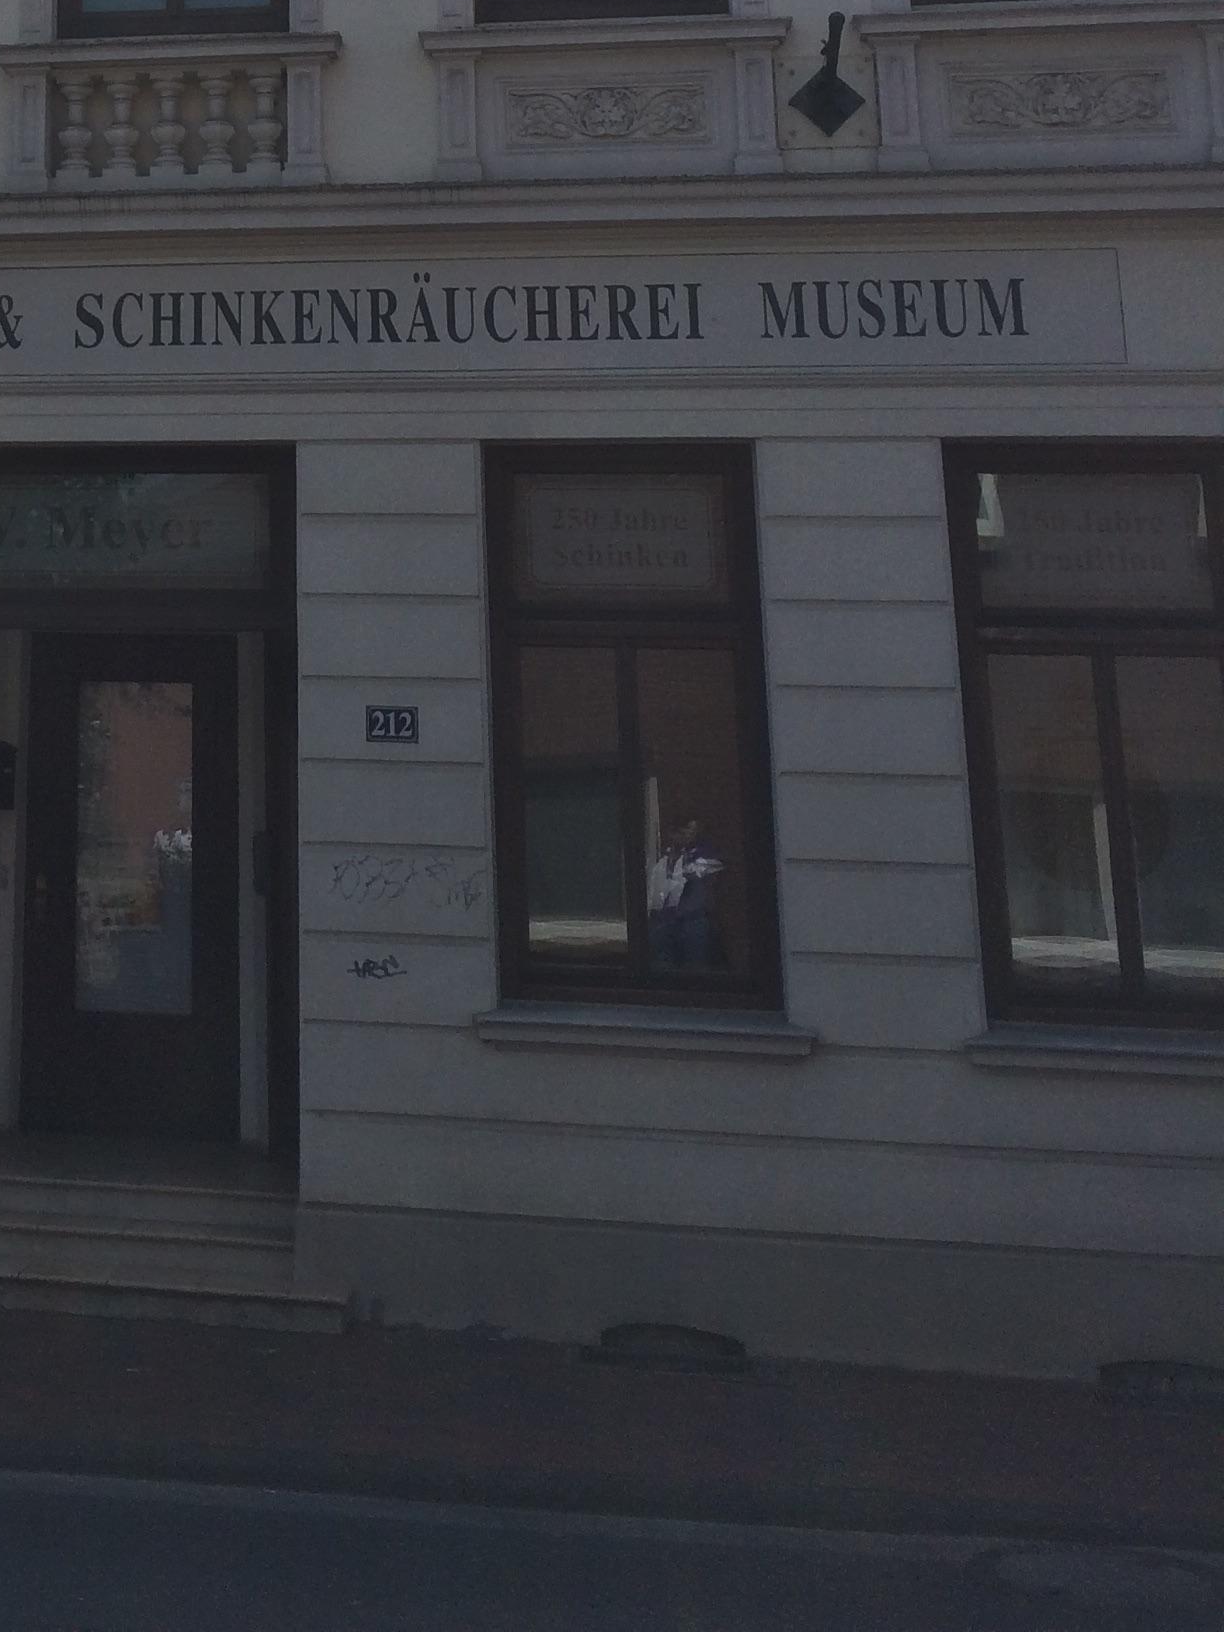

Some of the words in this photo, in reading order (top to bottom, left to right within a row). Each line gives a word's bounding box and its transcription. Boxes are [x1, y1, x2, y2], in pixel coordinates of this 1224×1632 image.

[75, 272, 706, 349] SCHINKENRÄUCHEREI
[758, 278, 1029, 339] MUSEUM
[45, 505, 214, 562] Meyer
[552, 542, 690, 568] Schinken
[371, 711, 413, 737] 212
